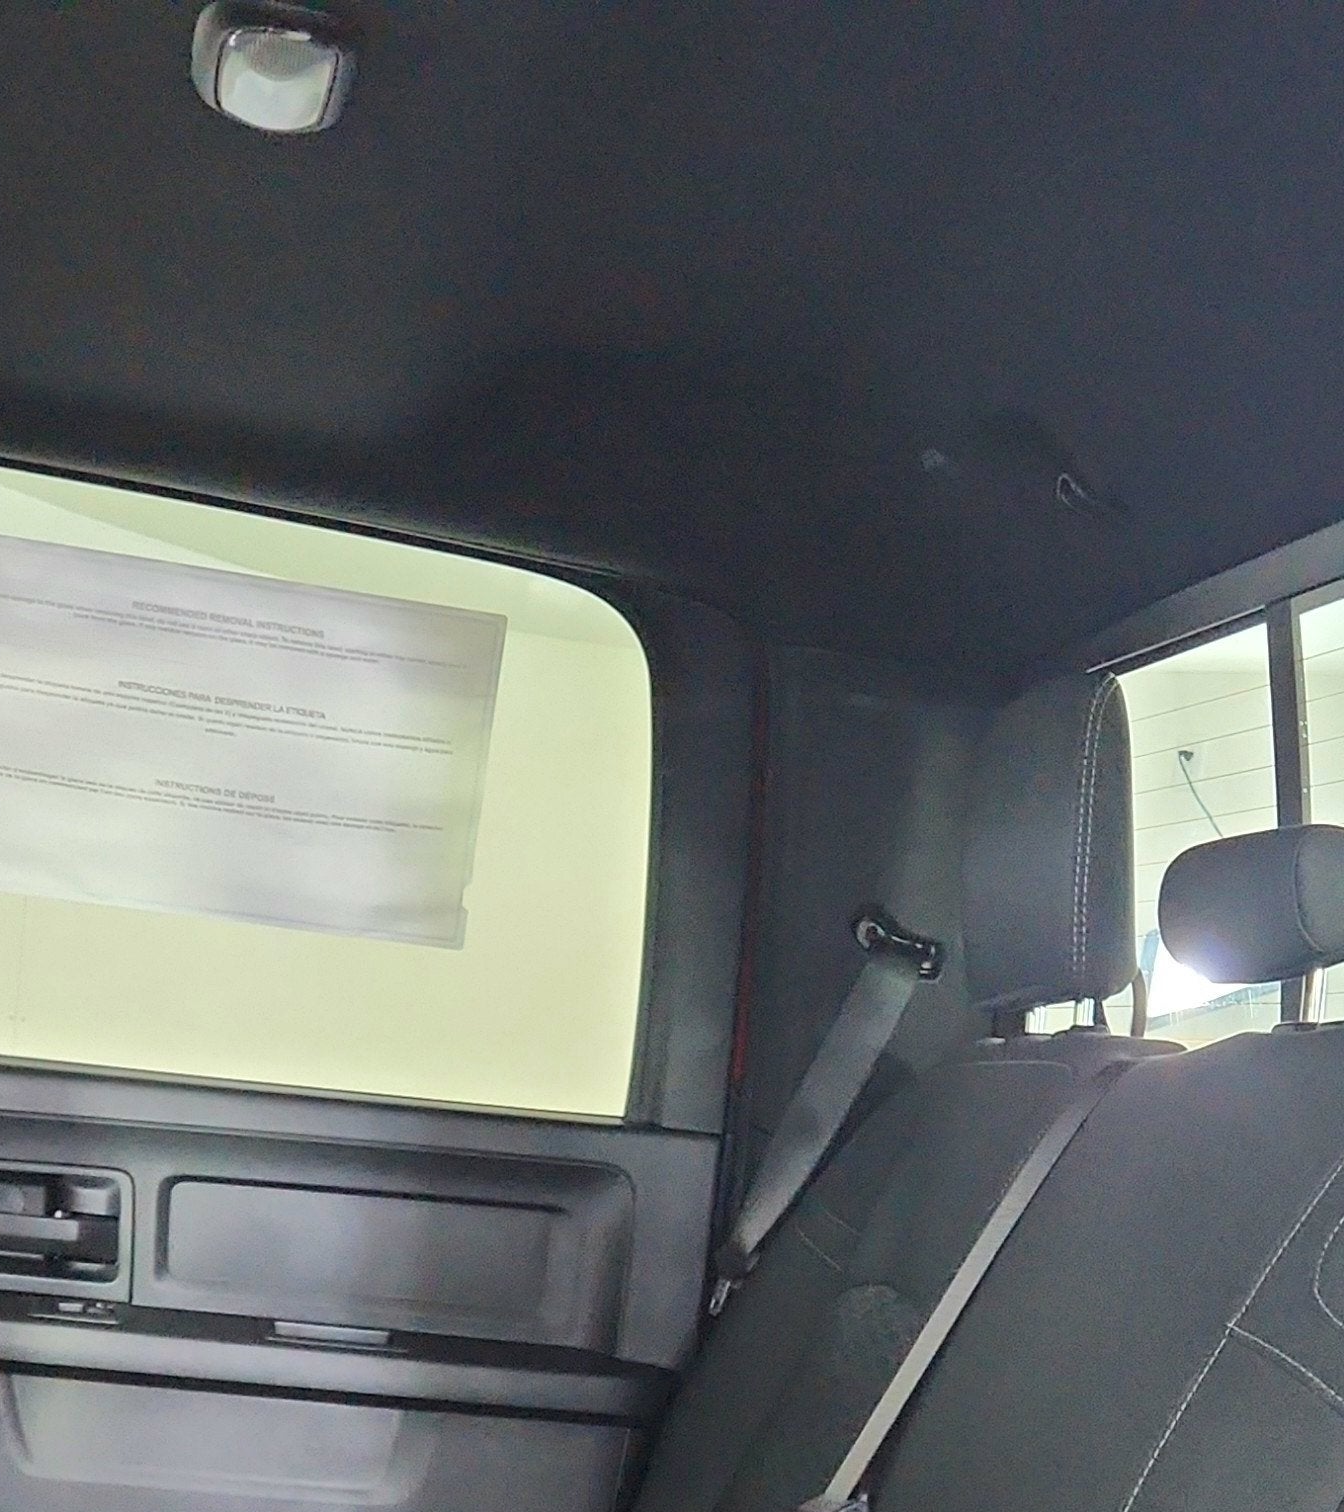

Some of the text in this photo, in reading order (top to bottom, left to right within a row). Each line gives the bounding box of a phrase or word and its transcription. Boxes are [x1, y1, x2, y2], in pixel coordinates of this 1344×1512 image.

[132, 601, 324, 638] RECOMMENDED REMOVAL INSTRUCTIONS
[118, 681, 186, 698] INSTRUCCIONES
[188, 692, 211, 703] PARA
[214, 697, 271, 711] DESPRENDER
[286, 706, 326, 720] ETIQUETA
[155, 779, 221, 797] INSTRUCTIONS
